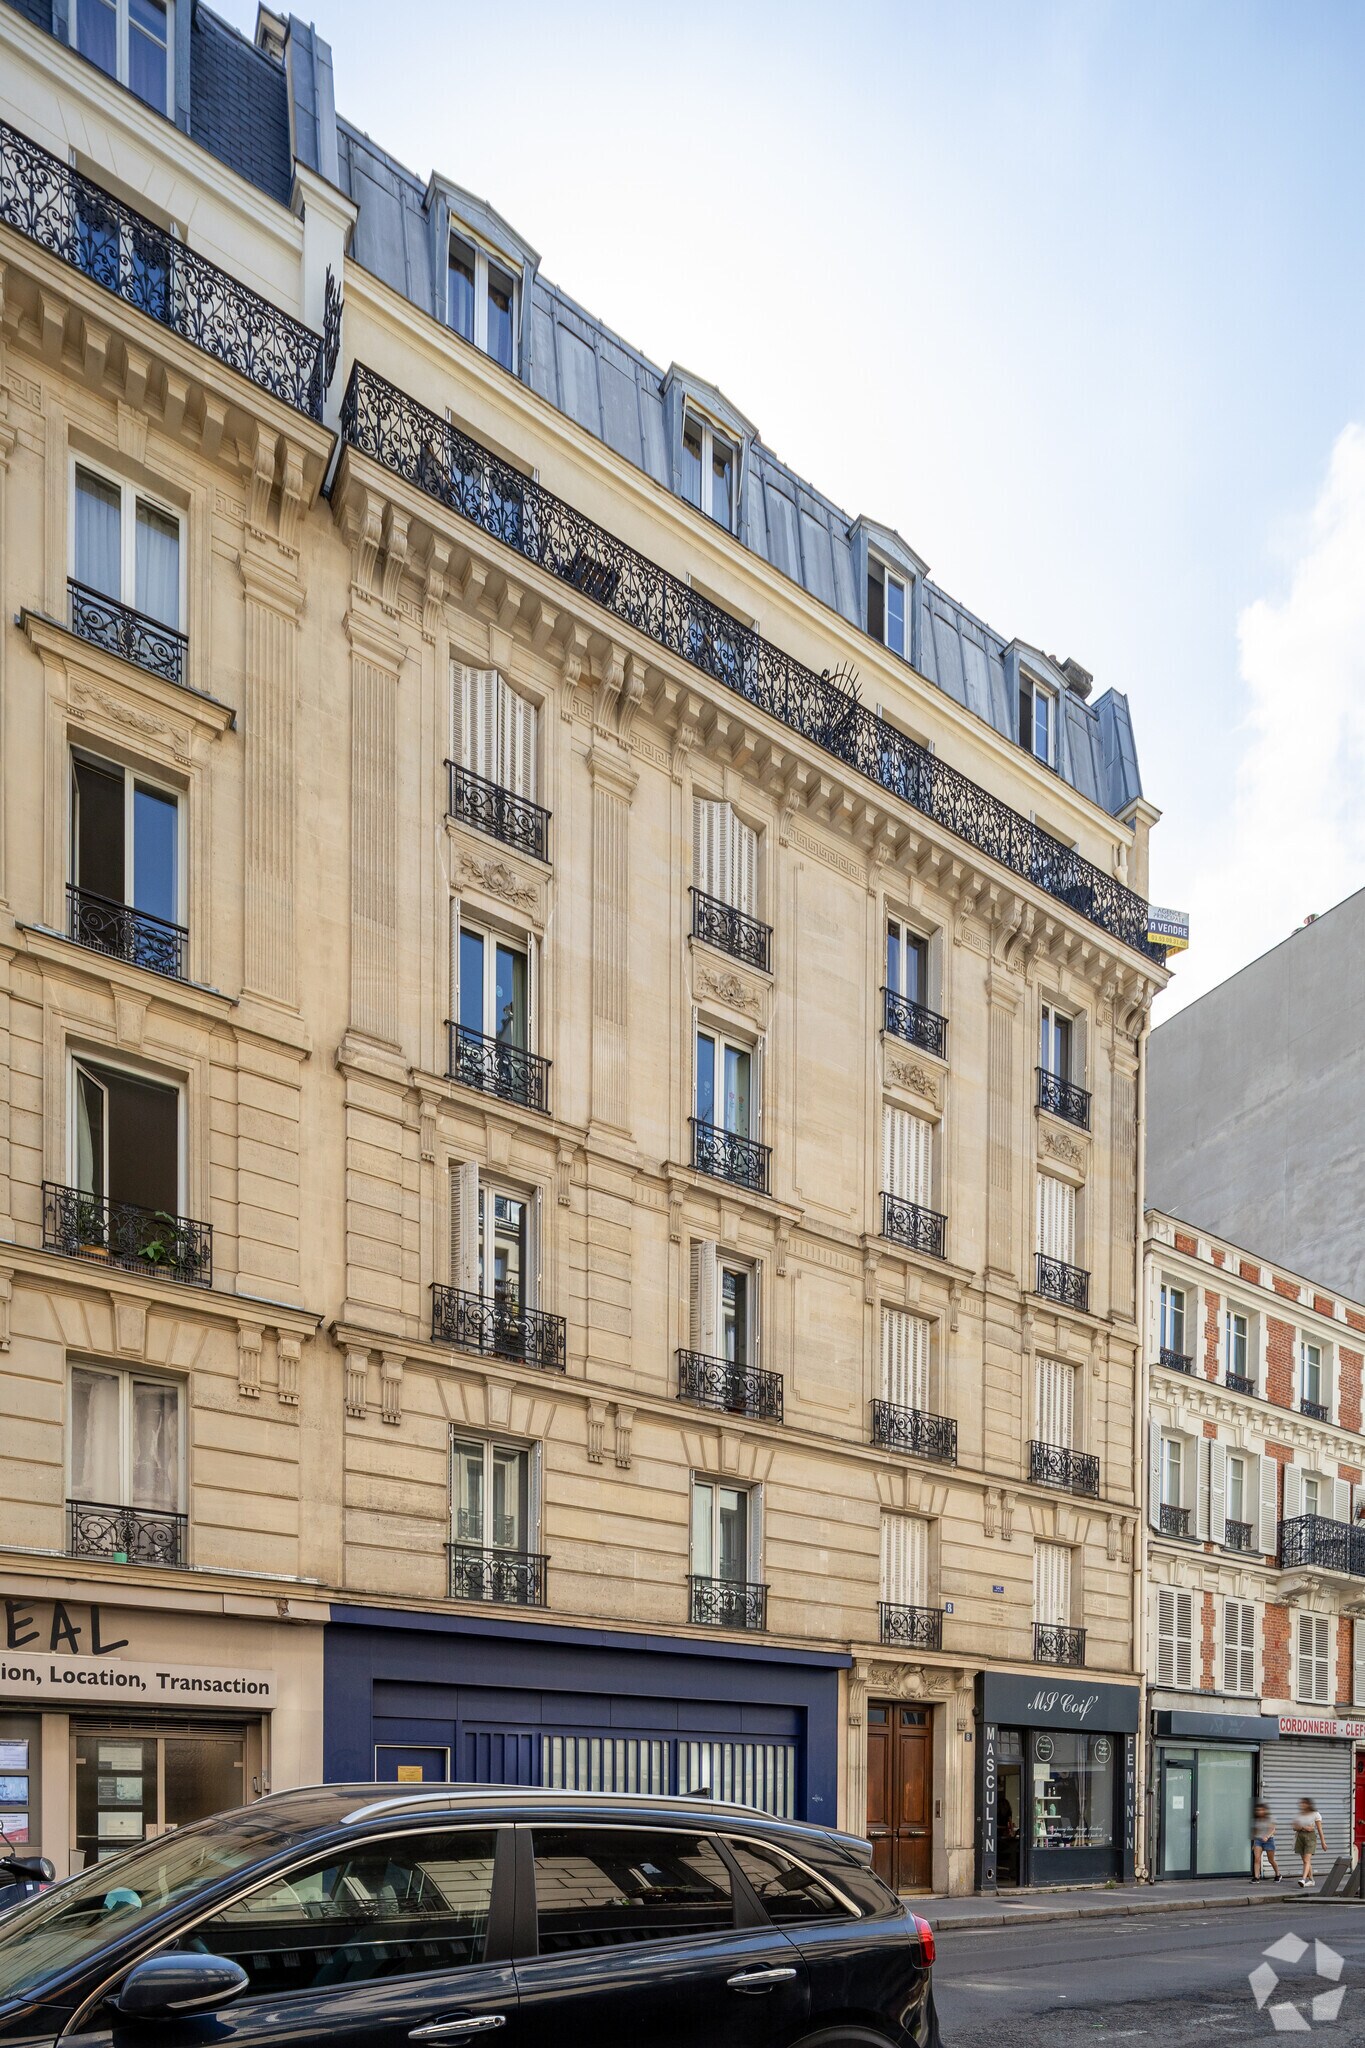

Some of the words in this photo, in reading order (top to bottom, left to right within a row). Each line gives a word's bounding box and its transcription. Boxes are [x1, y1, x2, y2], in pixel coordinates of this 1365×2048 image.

[1158, 922, 1188, 937] VENDRE
[5, 1599, 129, 1655] EAL
[50, 1665, 147, 1691] Location,
[156, 1672, 270, 1695] Transaction
[1280, 1717, 1337, 1735] CORDONNERIE
[985, 1726, 995, 1853] MASCULIN
[1126, 1736, 1134, 1850] FEMININ
